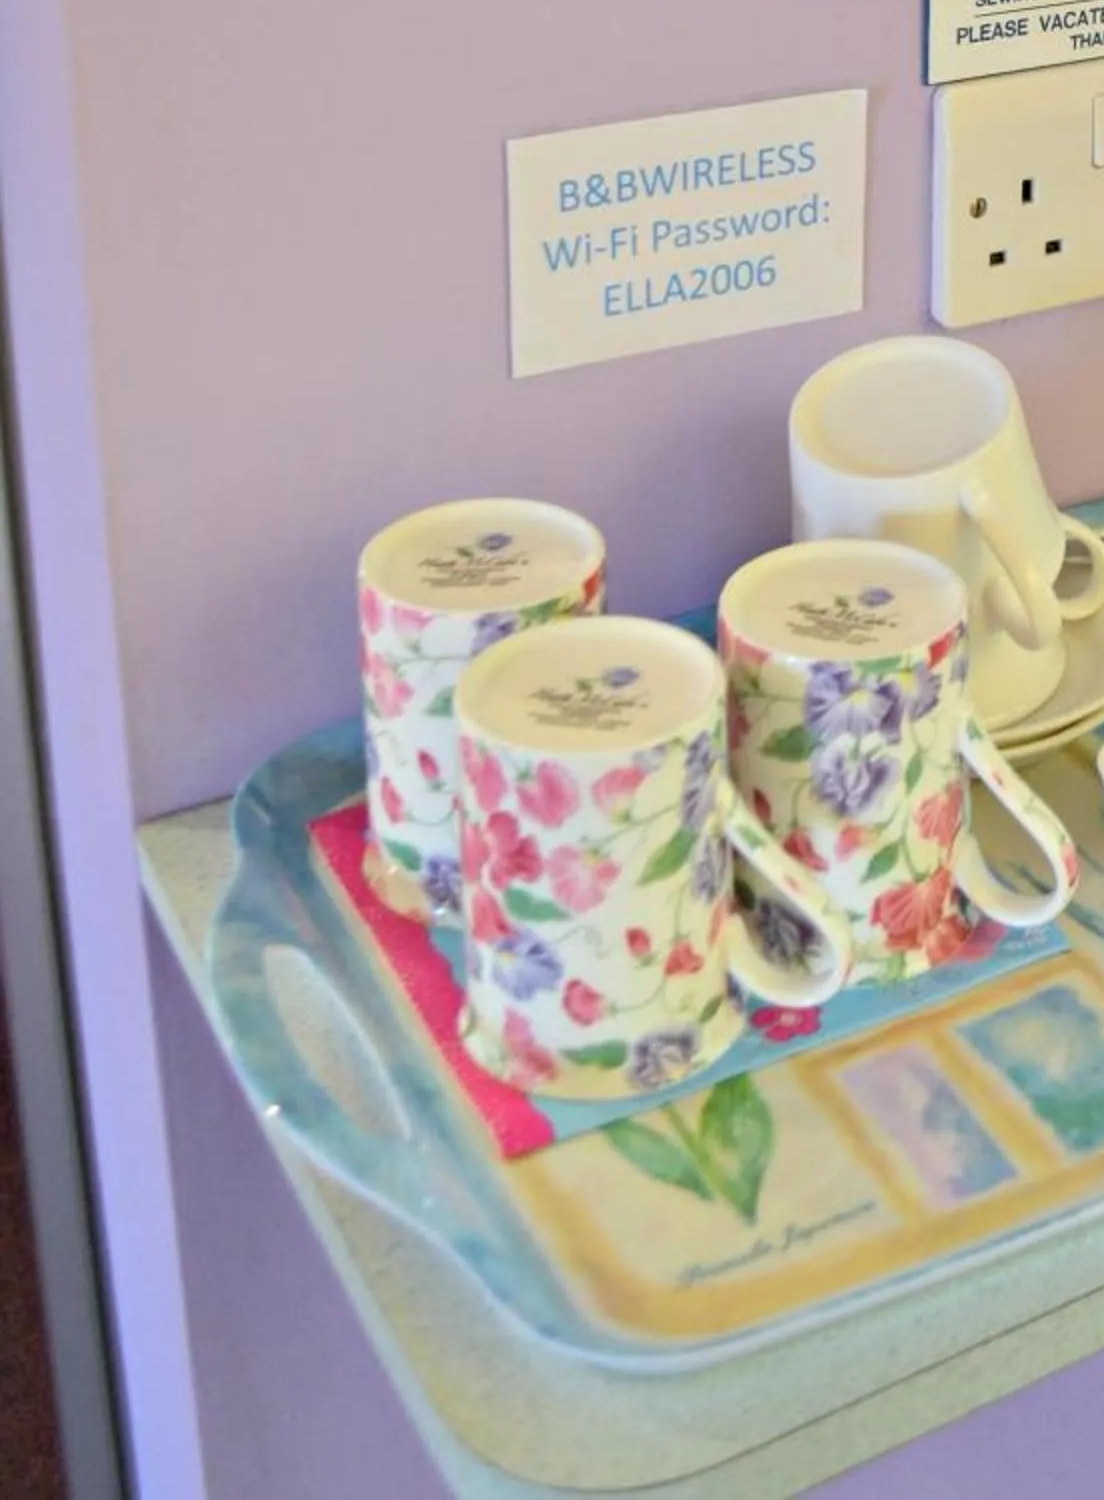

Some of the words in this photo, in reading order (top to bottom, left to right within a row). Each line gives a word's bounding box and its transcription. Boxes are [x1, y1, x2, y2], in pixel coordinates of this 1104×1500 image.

[956, 19, 1029, 44] PLEASE
[559, 141, 817, 212] B&BWIRELESS
[542, 226, 638, 272] Wi-Fi
[652, 193, 830, 253] Password:
[604, 255, 776, 317] ELLA2006
